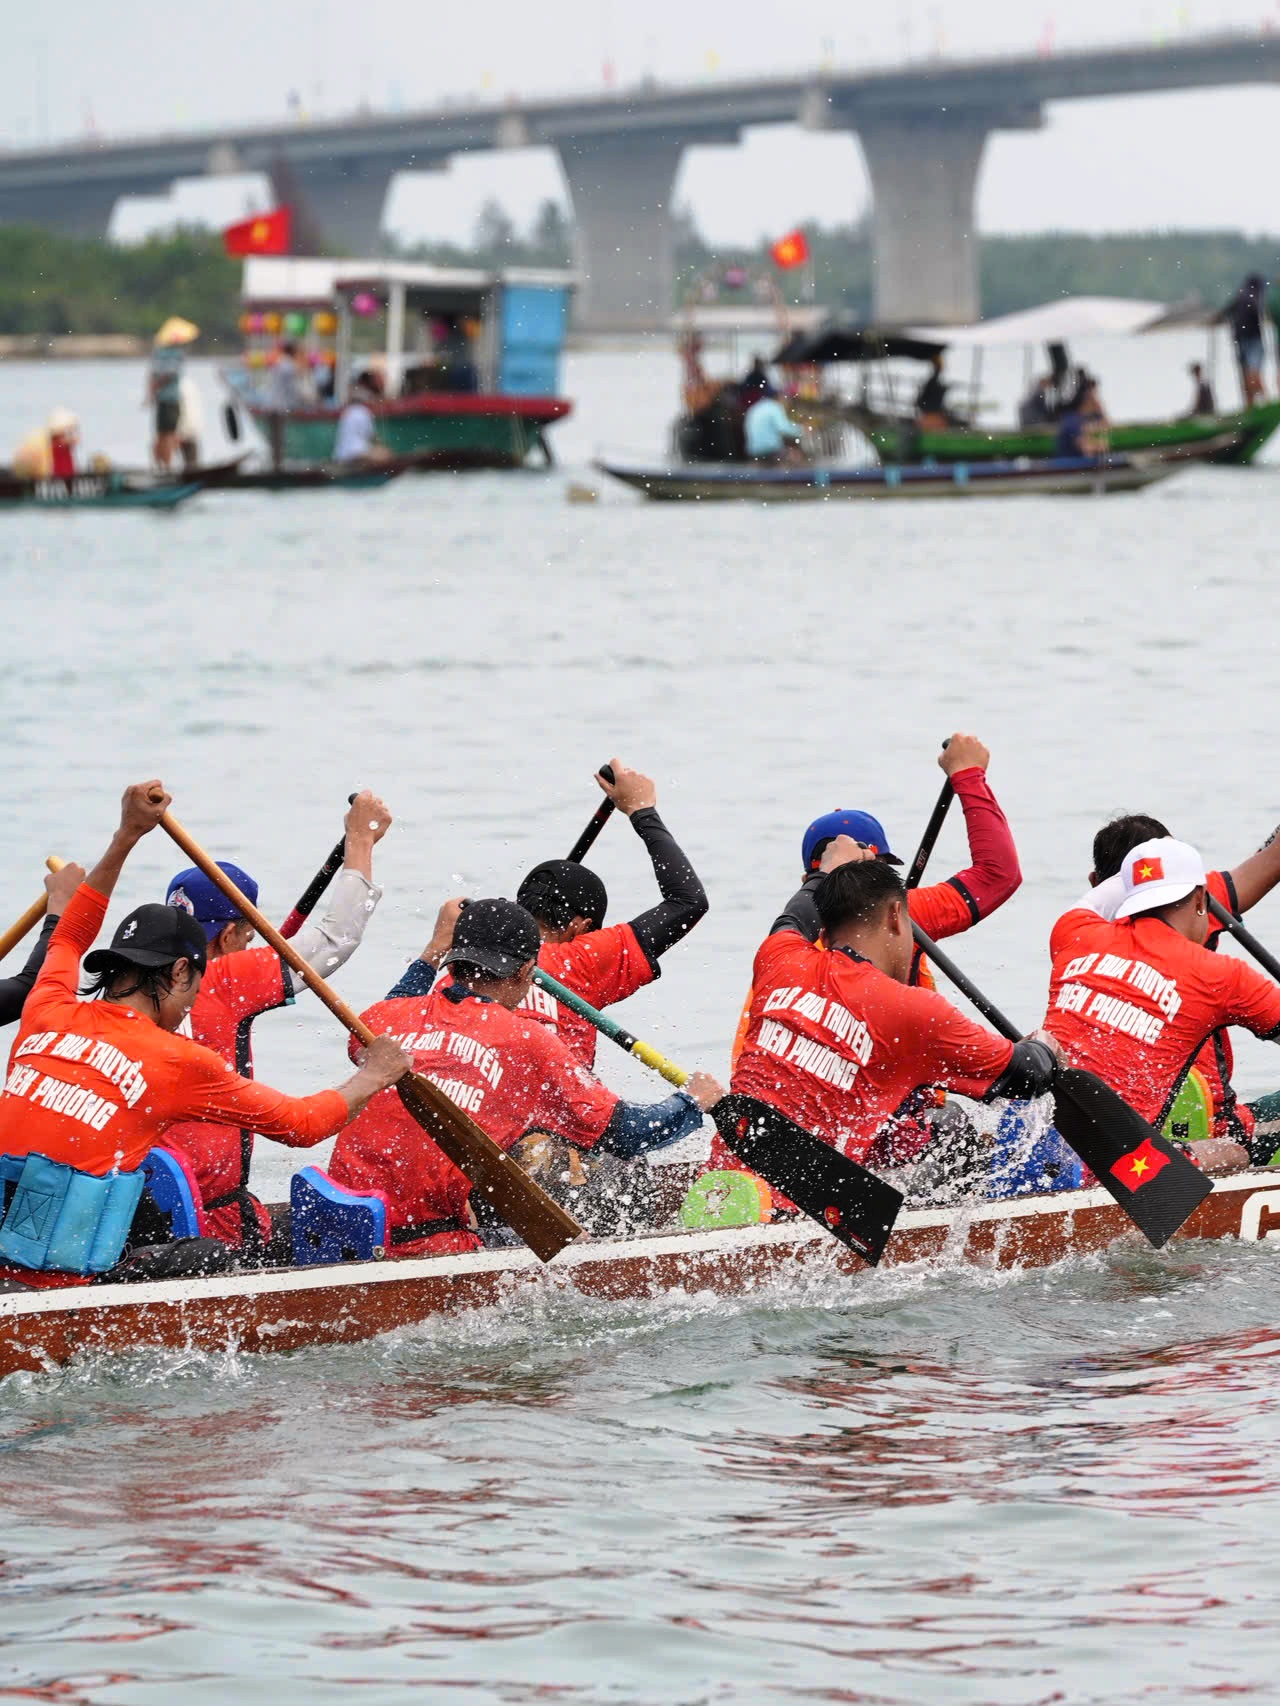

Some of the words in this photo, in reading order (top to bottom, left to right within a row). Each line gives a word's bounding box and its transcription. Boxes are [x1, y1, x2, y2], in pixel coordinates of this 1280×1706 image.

[1060, 952, 1100, 980] CLB
[762, 986, 803, 1012] CLB
[15, 1031, 59, 1058] CLB
